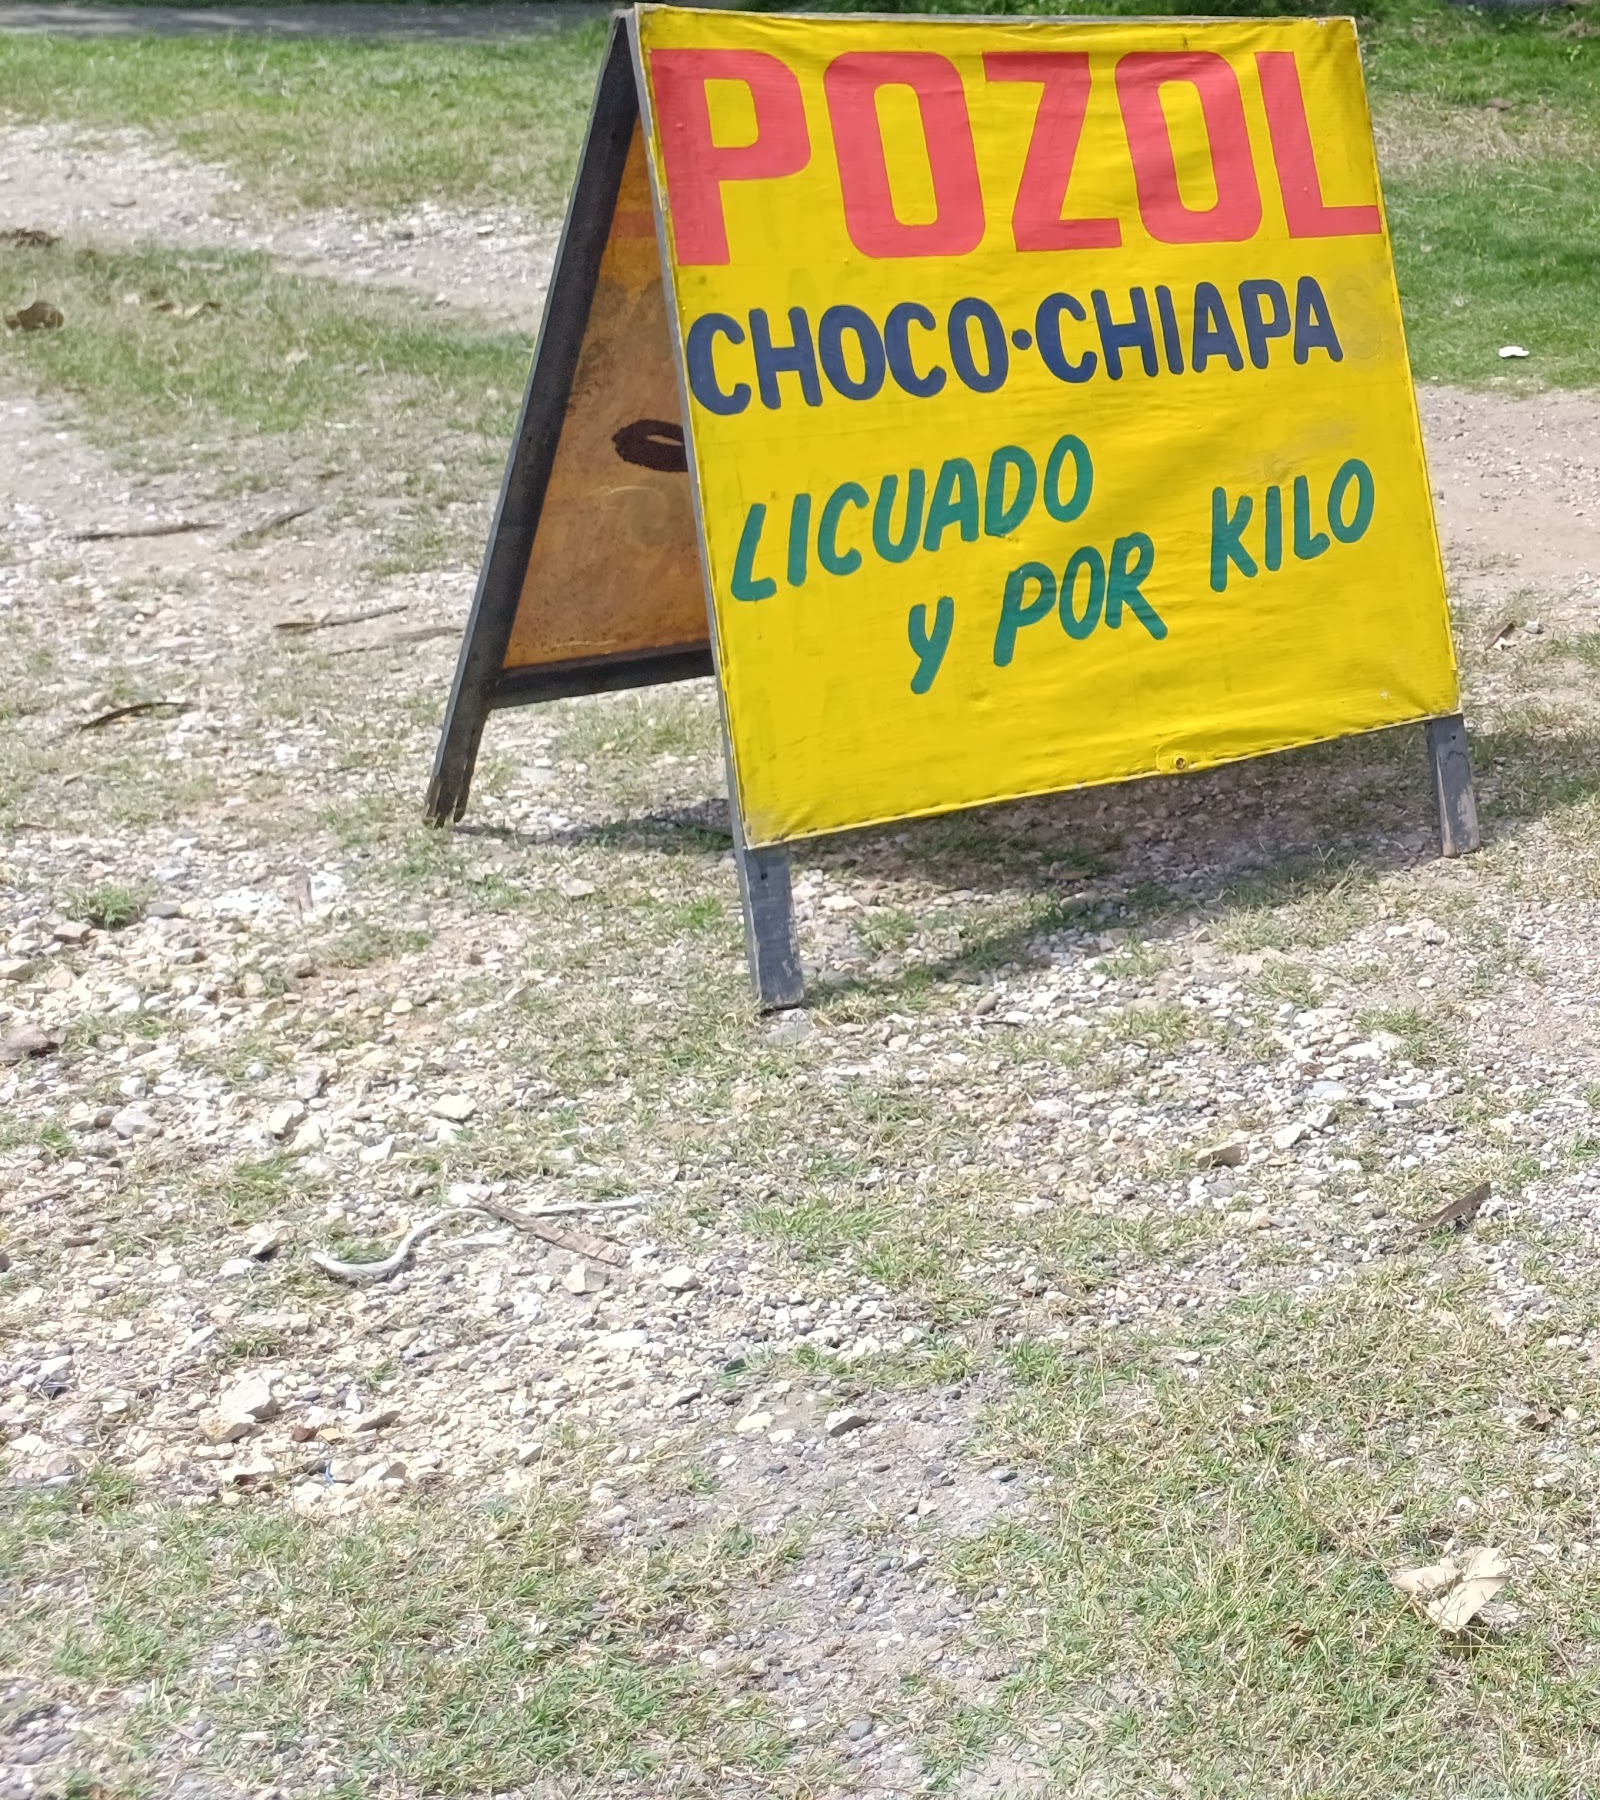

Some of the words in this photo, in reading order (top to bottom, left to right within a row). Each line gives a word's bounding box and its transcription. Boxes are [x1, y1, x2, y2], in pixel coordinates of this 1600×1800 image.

[650, 48, 1381, 266] POZOL
[731, 433, 1093, 601] LICUADO
[993, 531, 1167, 667] POR
[1210, 458, 1375, 592] KILO
